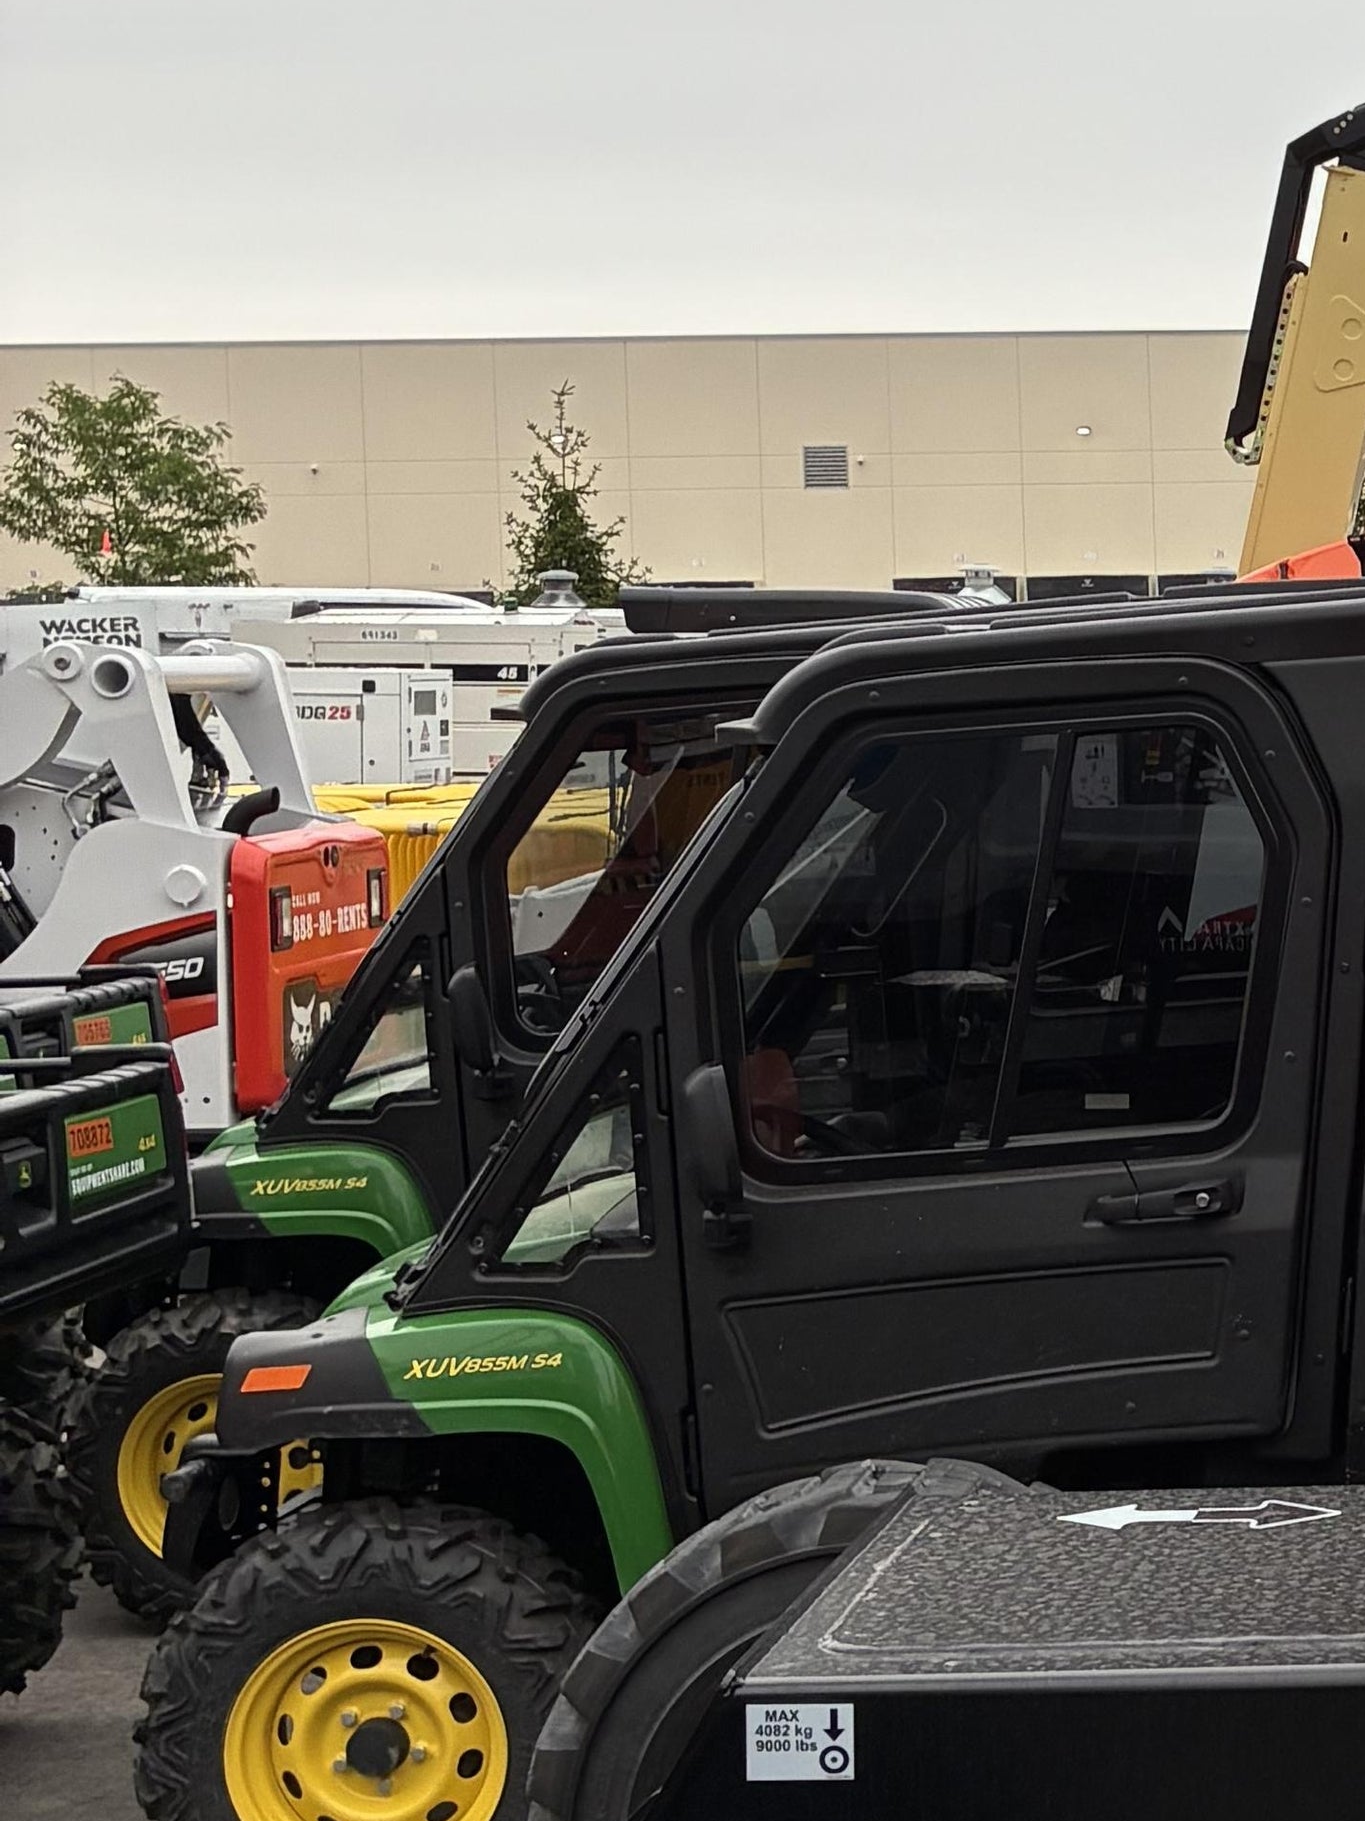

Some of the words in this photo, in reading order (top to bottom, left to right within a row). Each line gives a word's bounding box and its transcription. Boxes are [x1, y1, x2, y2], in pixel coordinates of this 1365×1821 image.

[39, 616, 140, 635] WACKER
[403, 1354, 529, 1380] XUV855M
[531, 1353, 563, 1370] S4
[765, 1709, 799, 1722] MAX
[755, 1724, 790, 1737] 4082
[795, 1724, 813, 1740] kg
[756, 1739, 791, 1752] 9000
[795, 1739, 818, 1752] lbs
